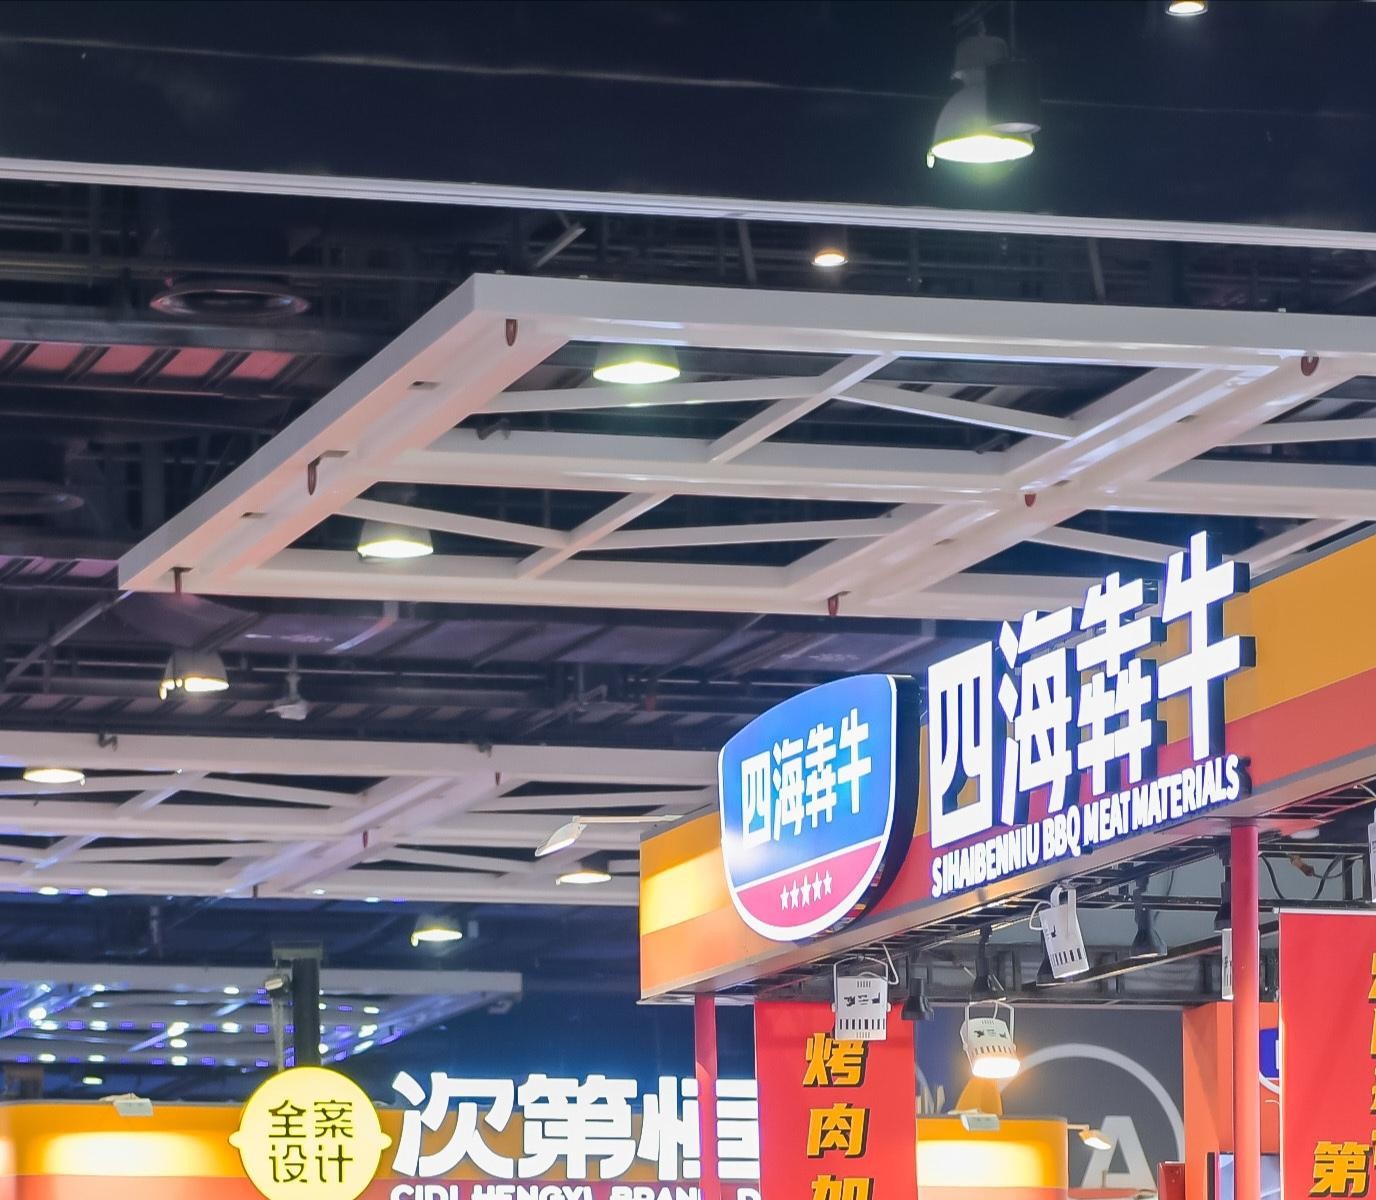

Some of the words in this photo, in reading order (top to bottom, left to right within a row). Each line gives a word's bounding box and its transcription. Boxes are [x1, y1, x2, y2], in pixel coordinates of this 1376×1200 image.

[928, 531, 1239, 848] 四海犇牛
[740, 708, 873, 850] 四海犇牛
[931, 827, 1042, 898] SIHAIBENNIU
[1042, 818, 1081, 861] BBQ
[1083, 797, 1133, 846] MEAT
[1132, 754, 1241, 831] MATERIALS
[268, 1099, 354, 1140] 全案
[268, 1145, 354, 1185] 设计
